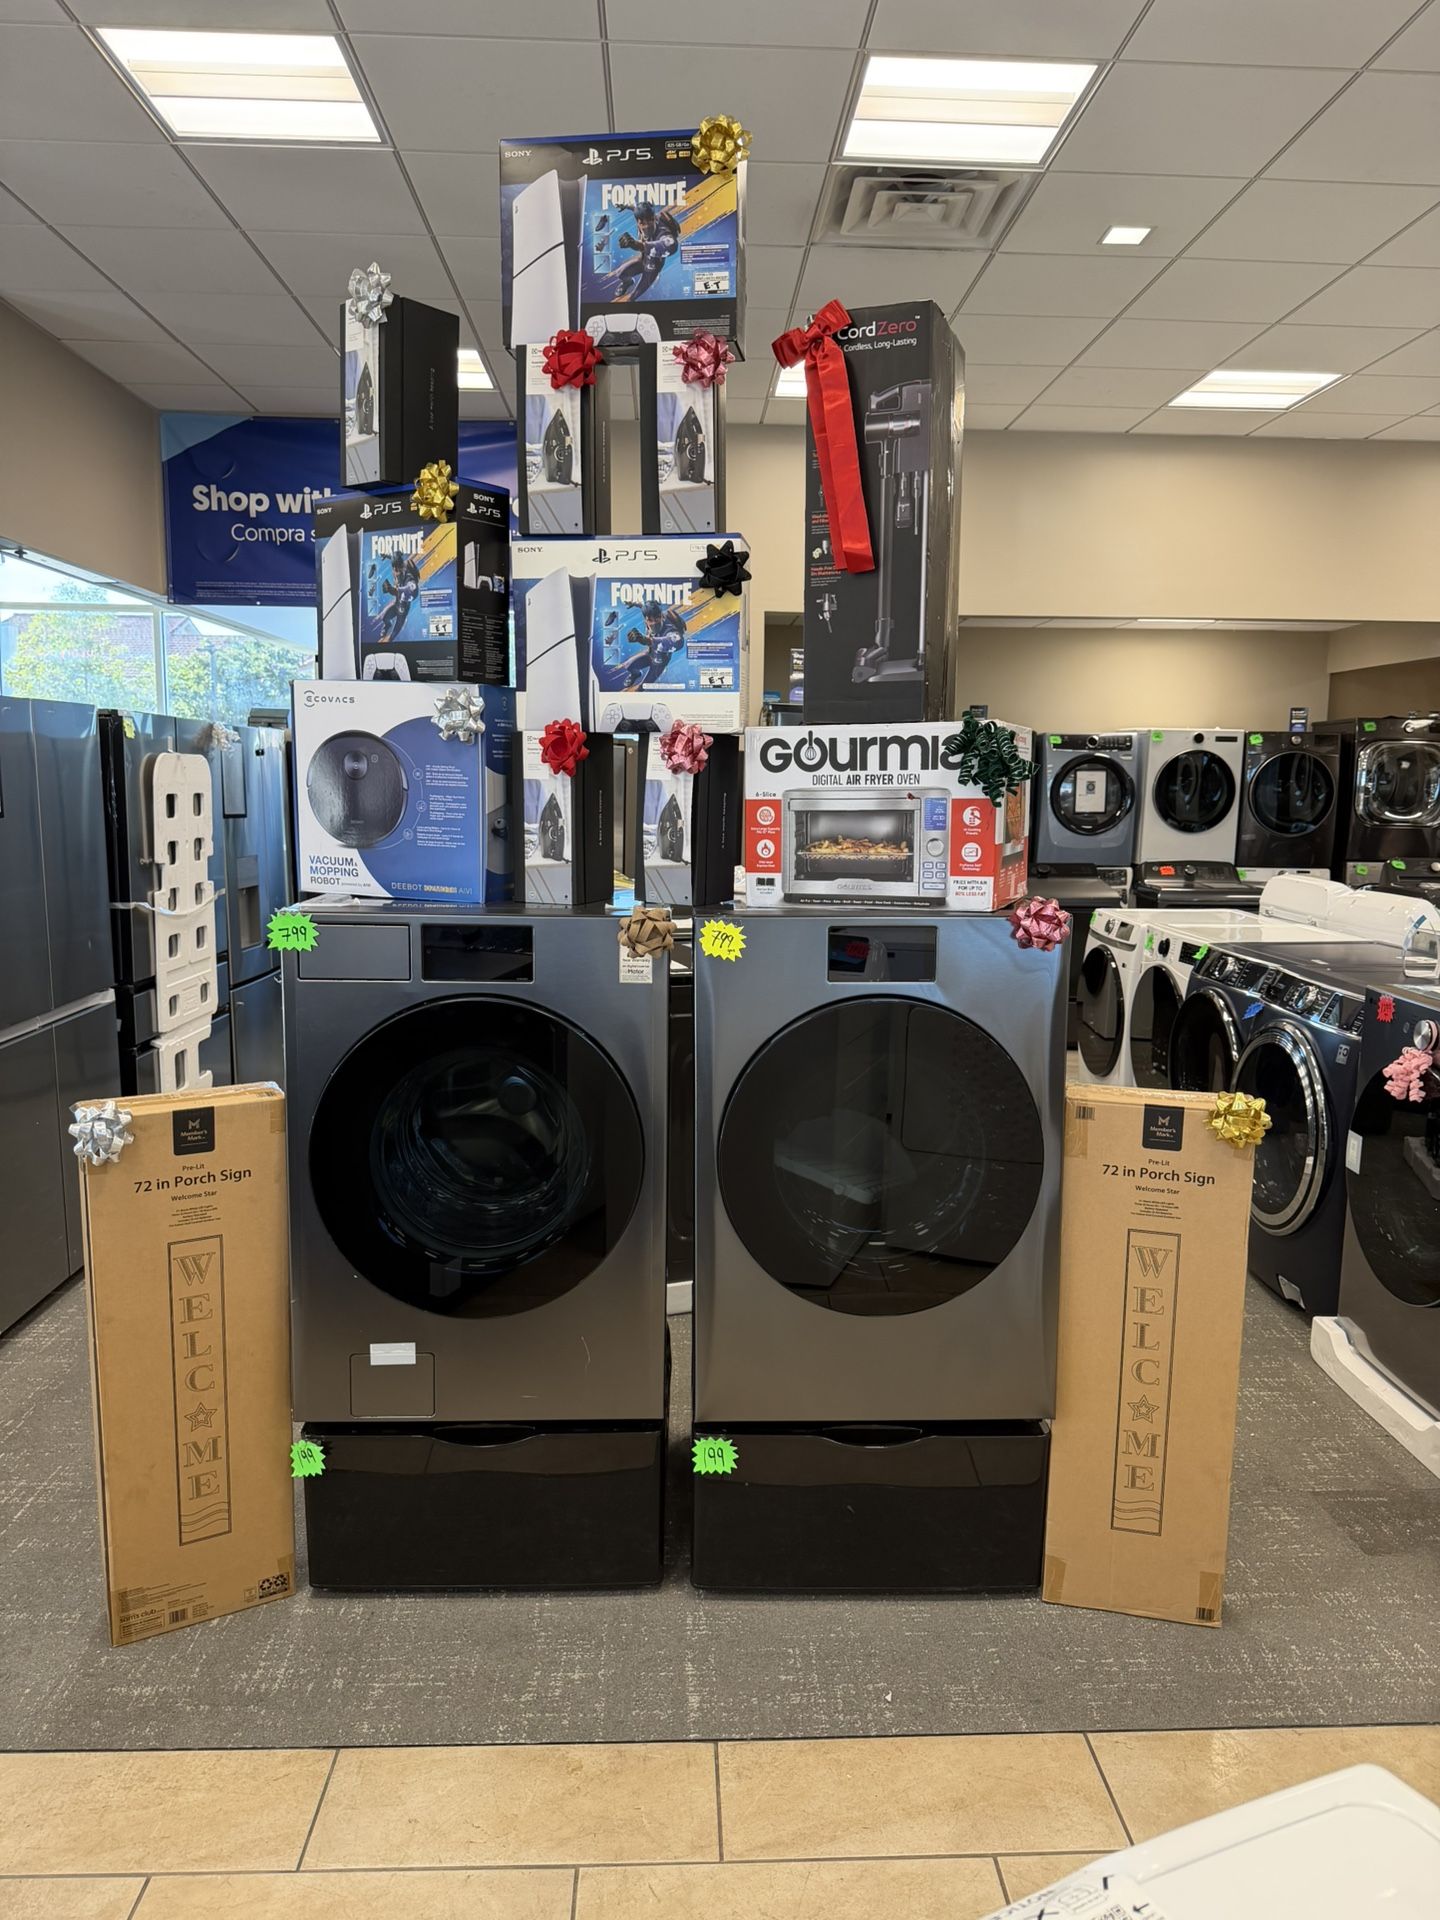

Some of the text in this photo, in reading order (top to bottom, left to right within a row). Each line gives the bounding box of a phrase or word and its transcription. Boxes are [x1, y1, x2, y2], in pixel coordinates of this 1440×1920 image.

[504, 150, 532, 158] SONY
[606, 148, 652, 162] PS5
[602, 180, 687, 210] FORTNITE
[843, 337, 917, 352] Cordless, Long-Lasting
[192, 484, 270, 518] Shop
[473, 493, 494, 503] SONY
[316, 507, 332, 515] SONY
[374, 501, 402, 516] PS5
[478, 506, 501, 518] PS5
[230, 524, 306, 546] Compra
[372, 532, 424, 559] FORTNITE
[615, 550, 660, 561] PS5
[610, 582, 692, 606] FORTNITE
[304, 692, 356, 706] ECOVACS
[812, 773, 920, 786] DIGITAL AIR FRYER OVEN
[309, 855, 354, 866] VACUUM
[310, 866, 359, 877] MOPPING
[310, 876, 340, 886] ROBOT
[392, 882, 422, 891] DEEBOT
[278, 926, 307, 942] 799
[712, 930, 734, 948] 799
[134, 1167, 252, 1194] 72 in Porch Sign
[1102, 1164, 1216, 1187] 72 in Porch Sign
[171, 1192, 202, 1202] Welcome
[1135, 1185, 1180, 1195] Welcome Star
[297, 1447, 317, 1469] 199
[704, 1447, 725, 1468] 199
